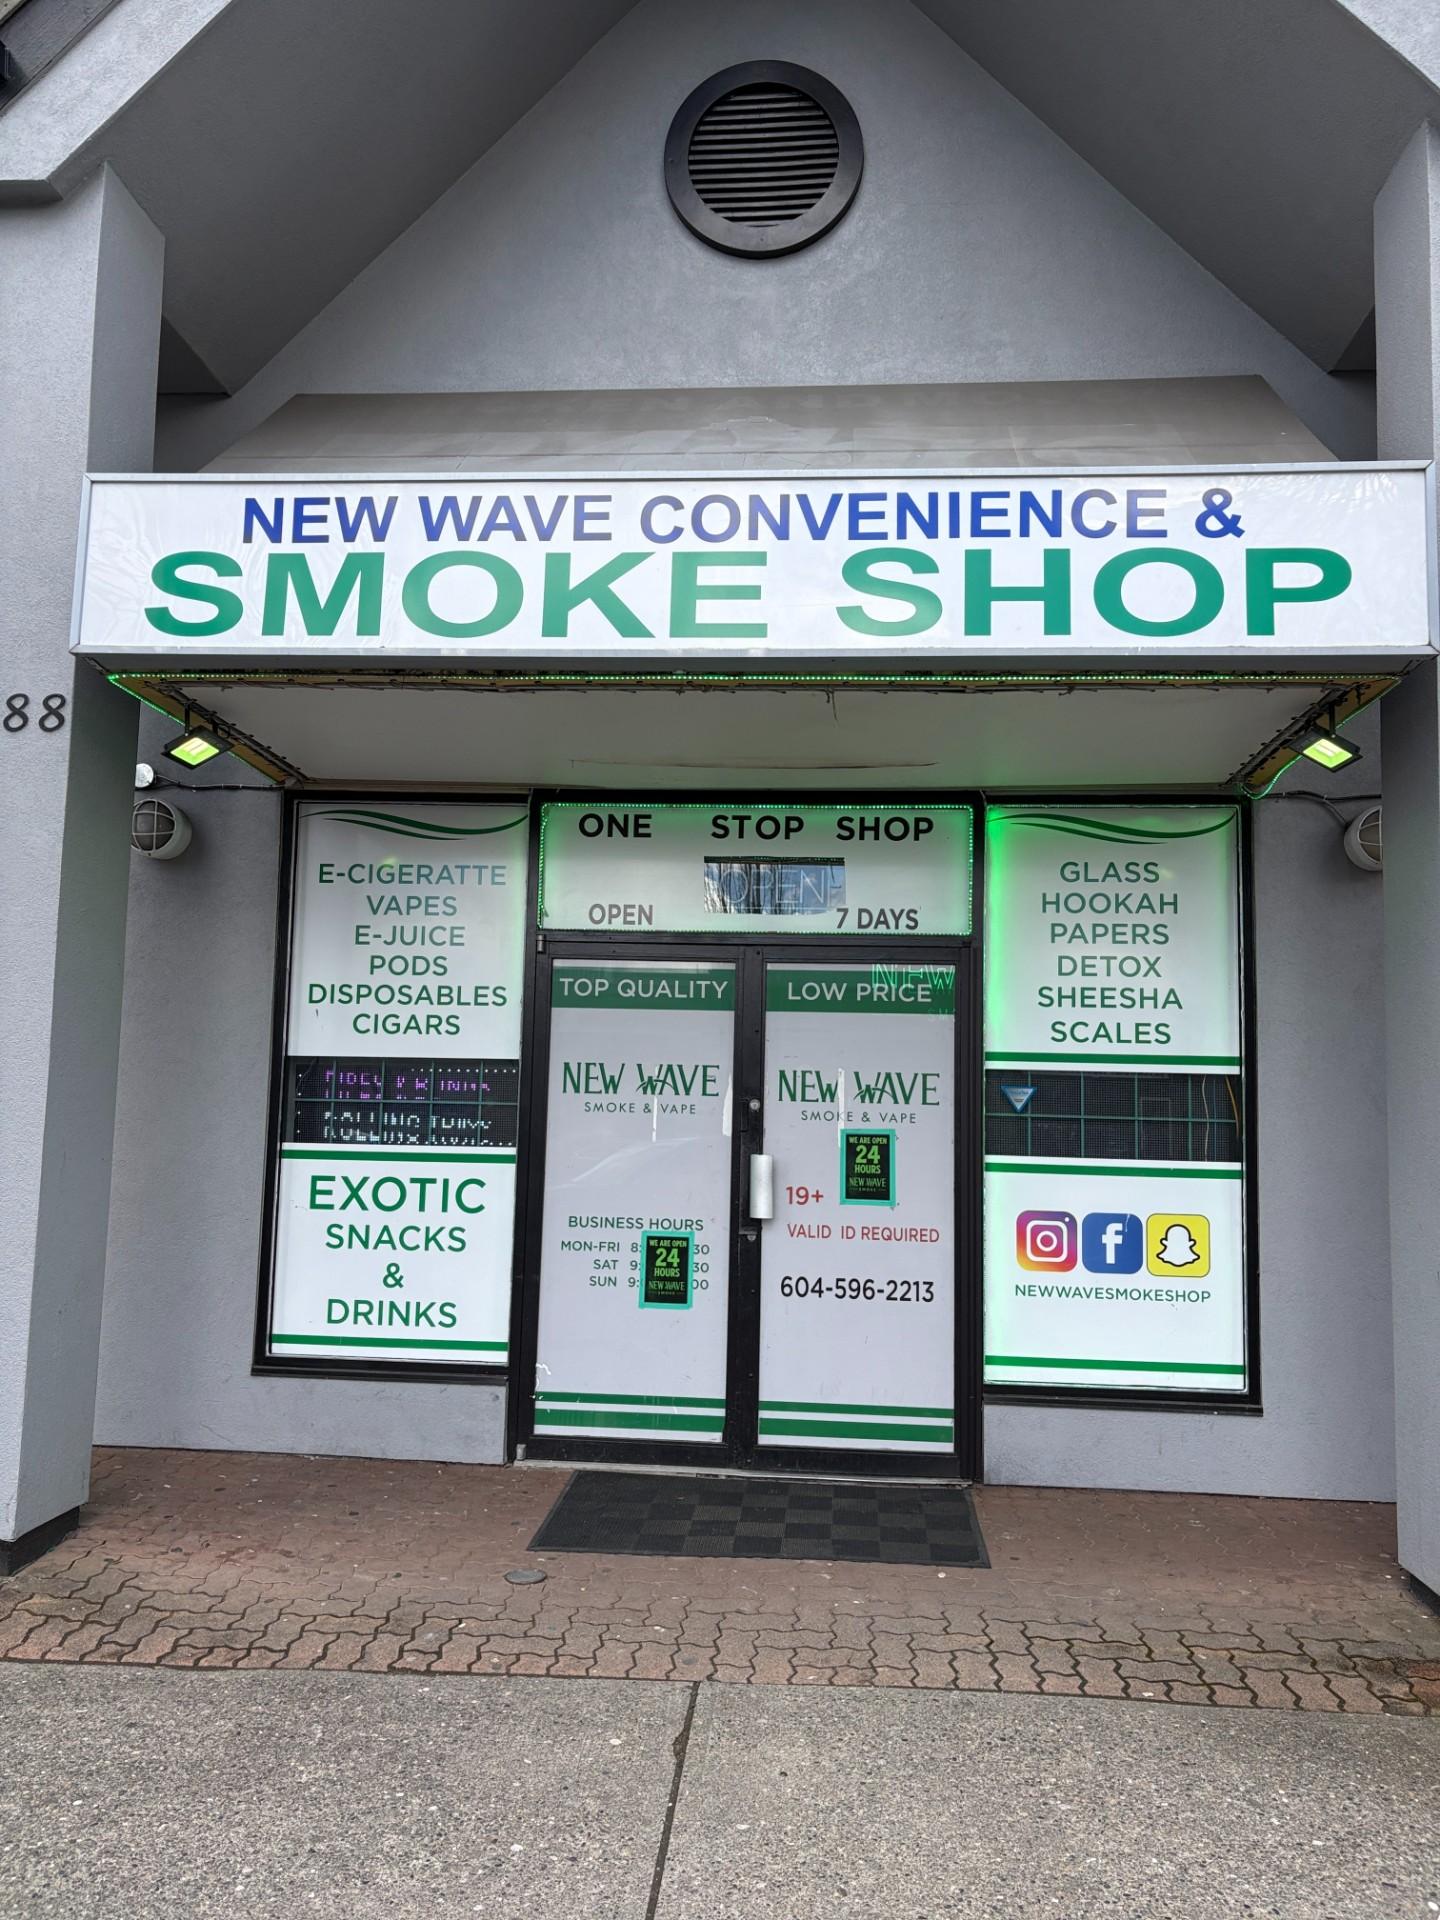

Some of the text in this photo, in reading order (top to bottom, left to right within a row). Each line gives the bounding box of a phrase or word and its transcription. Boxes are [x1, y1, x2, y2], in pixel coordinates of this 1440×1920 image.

[242, 487, 1246, 544] NEW WAVE CONVENIENCE &
[144, 547, 1352, 638] SMOKE SHOP
[3, 693, 66, 732] 88
[578, 813, 934, 842] ONE STOP SHOP
[318, 863, 507, 886] E-CIGERATTE
[1060, 862, 1160, 884] GLASS
[720, 869, 825, 904] OPEN
[366, 895, 458, 917] VAPES
[588, 903, 653, 926] OPEN
[1041, 892, 1178, 915] HOOKAH
[836, 908, 919, 931] 7 DAYS
[354, 925, 466, 947] E-JUICE
[1050, 923, 1170, 945] PAPERS
[369, 955, 448, 977] PODS
[1057, 955, 1162, 978] DETOX
[308, 983, 508, 1007] DISPOSABLES
[559, 977, 728, 999] TOP QUALITY
[788, 982, 932, 1003] LOW PRICE
[1038, 986, 1183, 1010] SHEESHA
[352, 1013, 461, 1035] CIGARS
[1050, 1021, 1171, 1045] SCALES
[562, 1062, 720, 1097] NEW WAVE
[778, 1070, 940, 1106] NEW WAVE
[584, 1102, 696, 1115] SMOKE & VAPE
[801, 1110, 916, 1124] SMOKE & VAPE
[849, 1136, 859, 1144] WE
[871, 1137, 887, 1145] OPEN
[855, 1144, 880, 1164] 24
[854, 1164, 881, 1174] HOURS
[309, 1175, 486, 1214] EXOTIC
[786, 1187, 824, 1205] 19+
[568, 1216, 704, 1231] BUSINESS HOURS
[787, 1224, 939, 1243] VALID ID REQUIRED
[325, 1223, 467, 1252] SNACKS
[561, 1240, 620, 1253] MON-FRI
[672, 1240, 687, 1248] OPEN
[593, 1259, 619, 1270] SAT
[655, 1247, 680, 1267] 24
[382, 1262, 404, 1288] &
[589, 1276, 617, 1287] SUN
[654, 1267, 680, 1278] HOURS
[780, 1276, 934, 1302] 604-596-2213
[1015, 1284, 1211, 1303] NEWWAVESMOKESHOP
[326, 1298, 457, 1328] DRINKS
